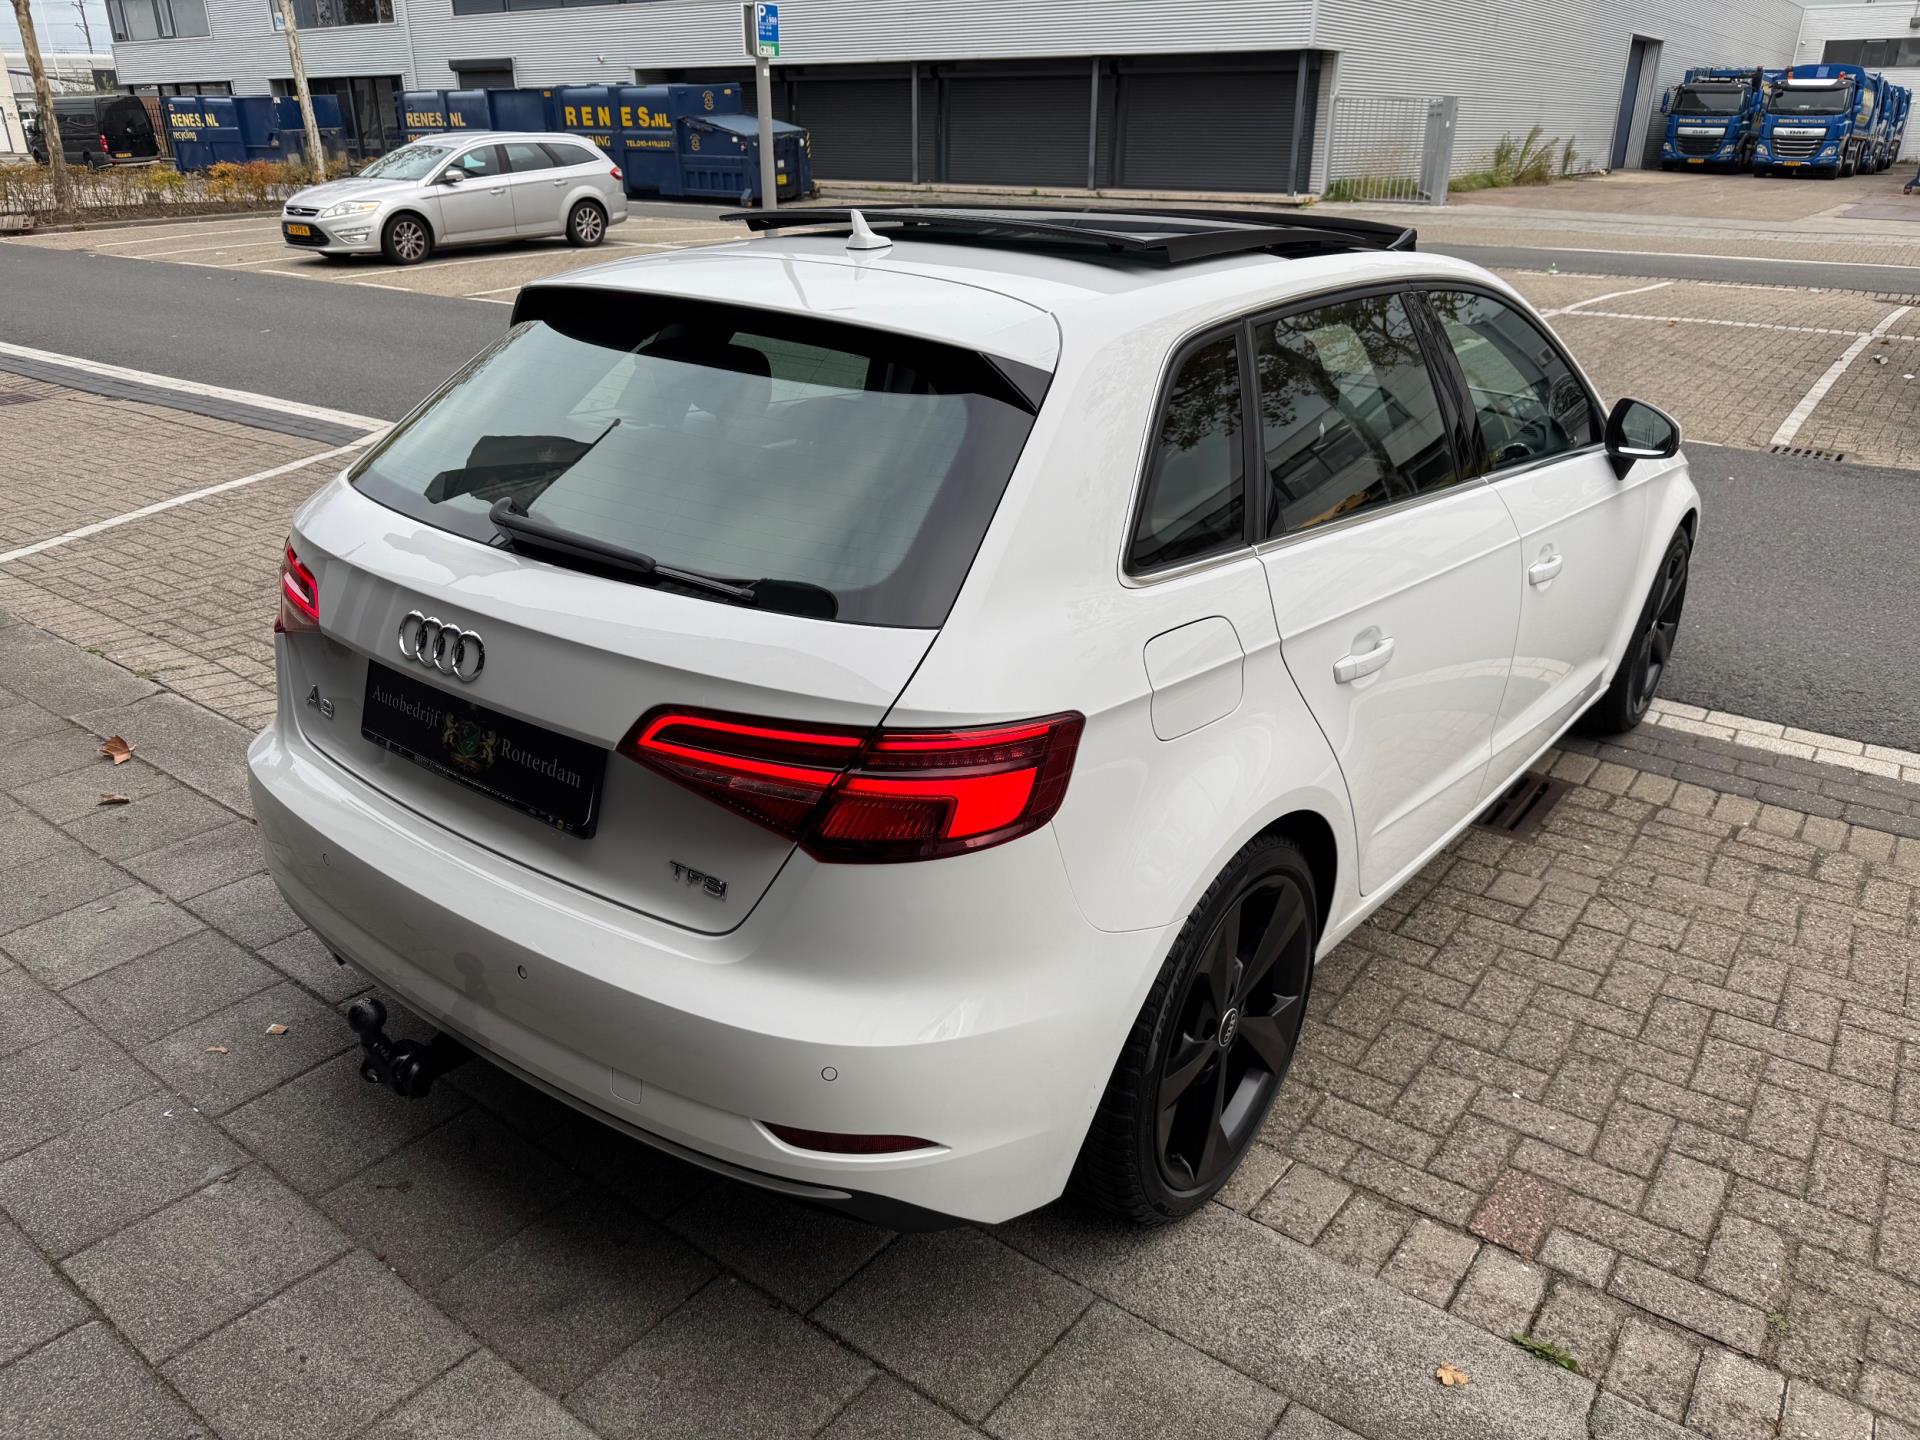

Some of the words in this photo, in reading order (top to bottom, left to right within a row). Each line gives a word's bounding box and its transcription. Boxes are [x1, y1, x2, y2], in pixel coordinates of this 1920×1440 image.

[758, 5, 767, 22] P
[305, 684, 335, 720] A3
[372, 684, 442, 730] Autobedrijf
[502, 738, 582, 789] Rotterdam
[669, 860, 729, 902] TFSI
